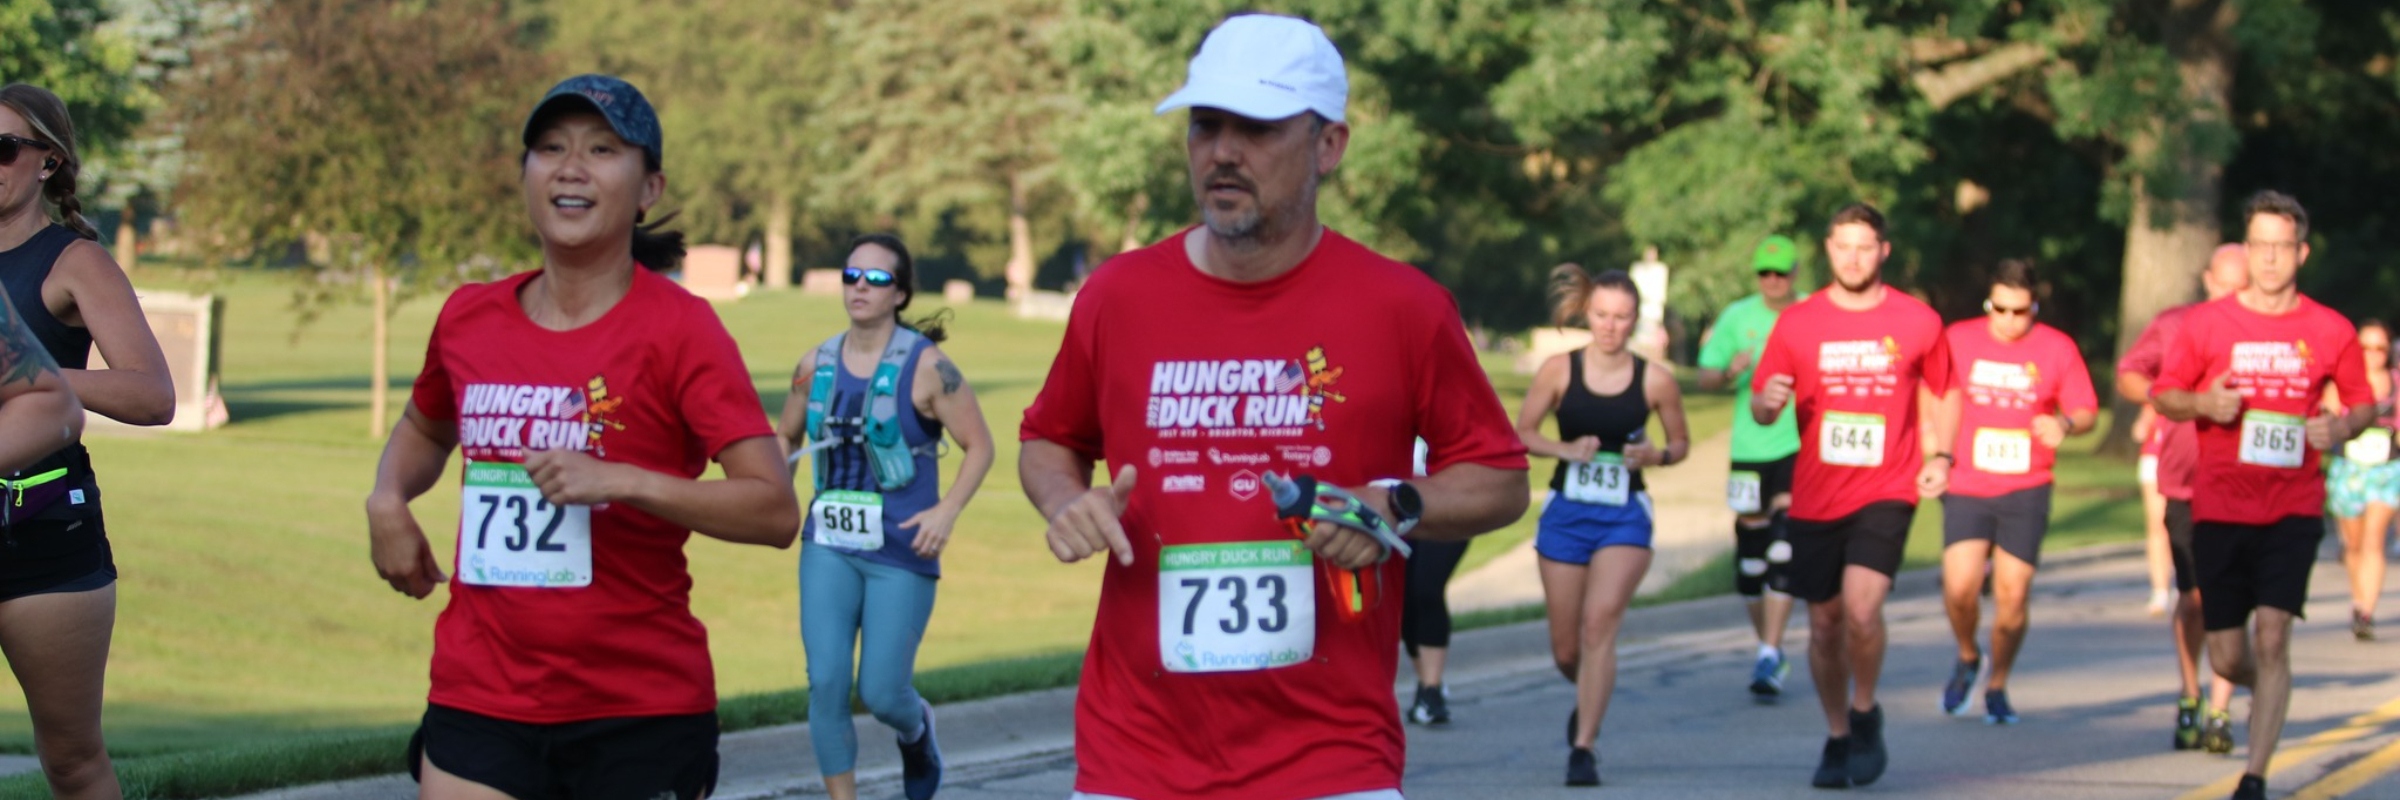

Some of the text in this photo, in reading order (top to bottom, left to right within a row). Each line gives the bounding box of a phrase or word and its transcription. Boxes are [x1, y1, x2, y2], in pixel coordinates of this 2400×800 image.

[1151, 359, 1286, 394] HUNGRY
[461, 384, 571, 418] HUNGRY
[1158, 394, 1310, 428] DUCK RUN
[463, 417, 527, 447] DUCK
[528, 419, 589, 451] RUN
[1832, 425, 1873, 450] 644
[2253, 425, 2298, 452] 865
[469, 467, 509, 483] HUNGRY
[1232, 478, 1257, 492] GU
[1578, 463, 1620, 489] 643
[477, 494, 566, 552] 732
[823, 504, 870, 534] 581
[1164, 548, 1291, 566] HUNGRY DUCK RUN
[490, 566, 576, 586] RunningLab
[1180, 574, 1288, 635] 733
[1202, 648, 1299, 669] RunningLab
